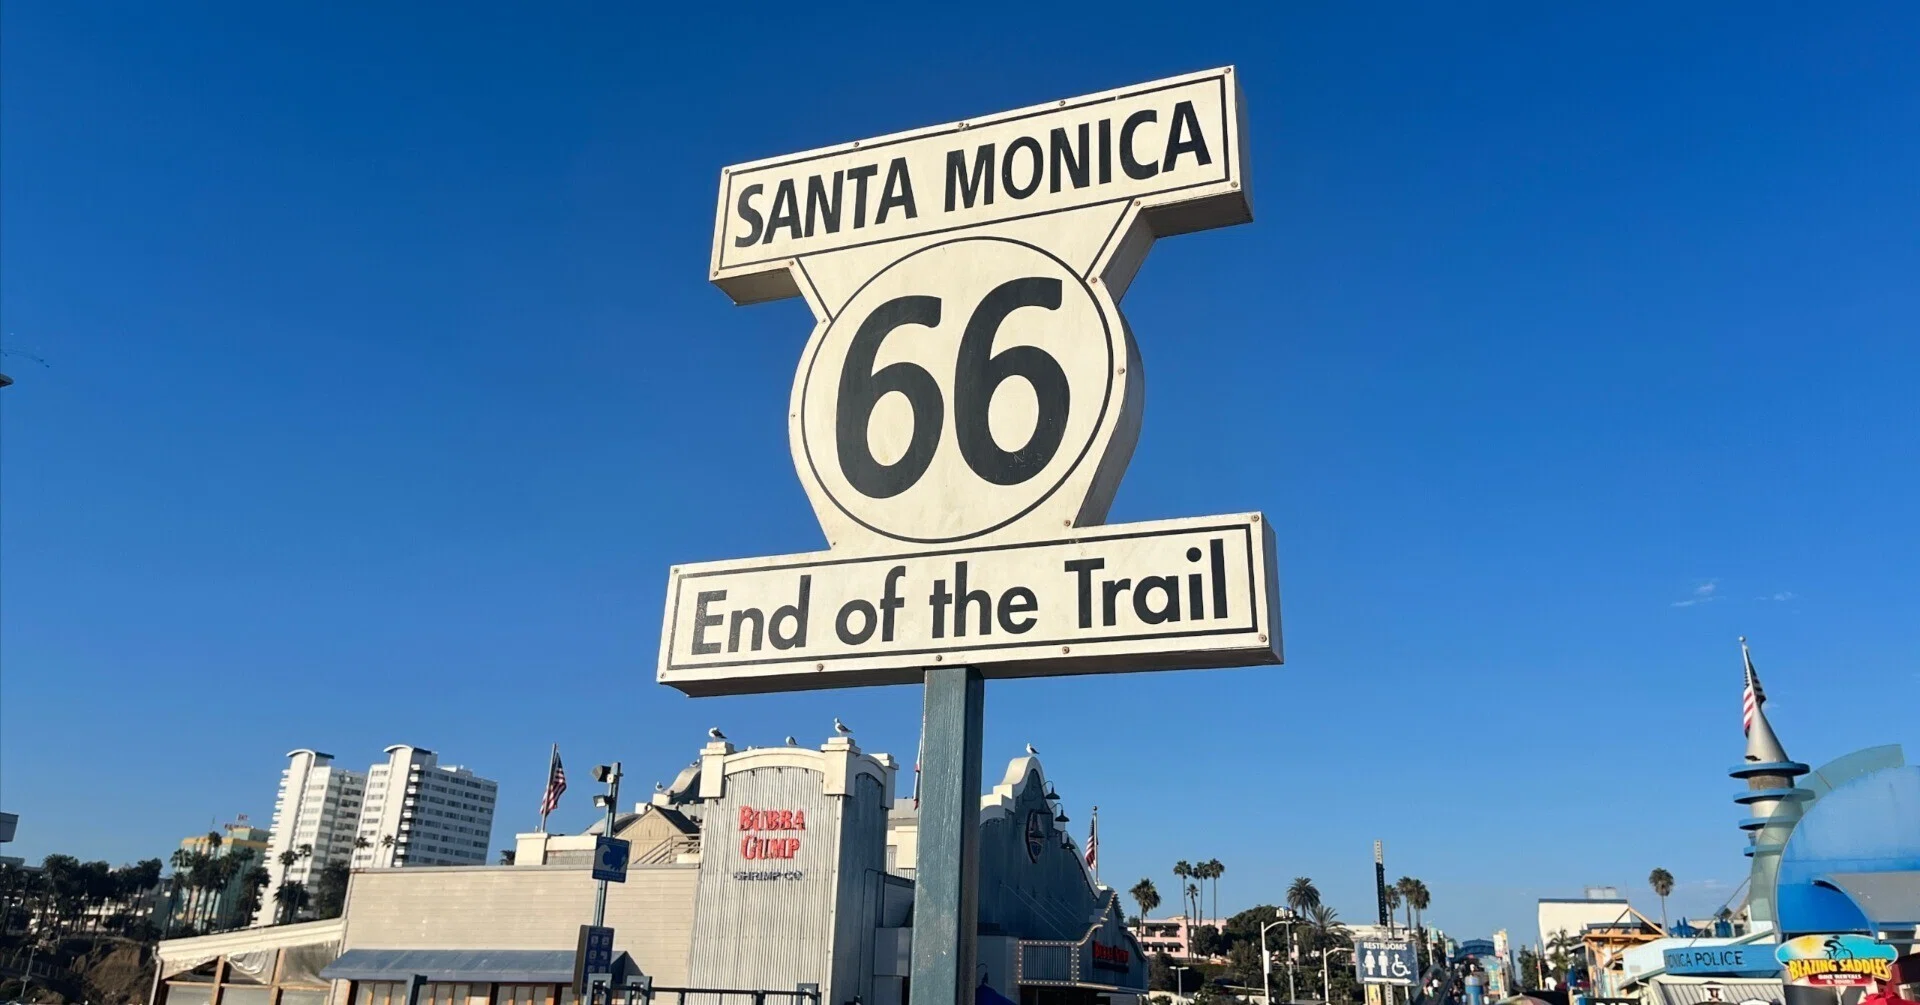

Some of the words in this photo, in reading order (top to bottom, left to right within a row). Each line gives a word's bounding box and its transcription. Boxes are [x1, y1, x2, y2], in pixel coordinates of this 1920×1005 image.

[735, 156, 917, 248] SANTA
[944, 100, 1213, 213] MONICA
[835, 276, 1071, 499] 66
[690, 574, 812, 656] End
[835, 565, 906, 646] of
[929, 560, 1039, 639] the
[1065, 538, 1228, 629] Trail
[739, 806, 805, 831] BUBBA
[741, 835, 800, 860] GUMP
[1363, 942, 1407, 950] RESTROOMS
[1695, 951, 1744, 967] POLICE
[1788, 959, 1838, 980] BLAZING
[1839, 959, 1891, 980] SADDLES
